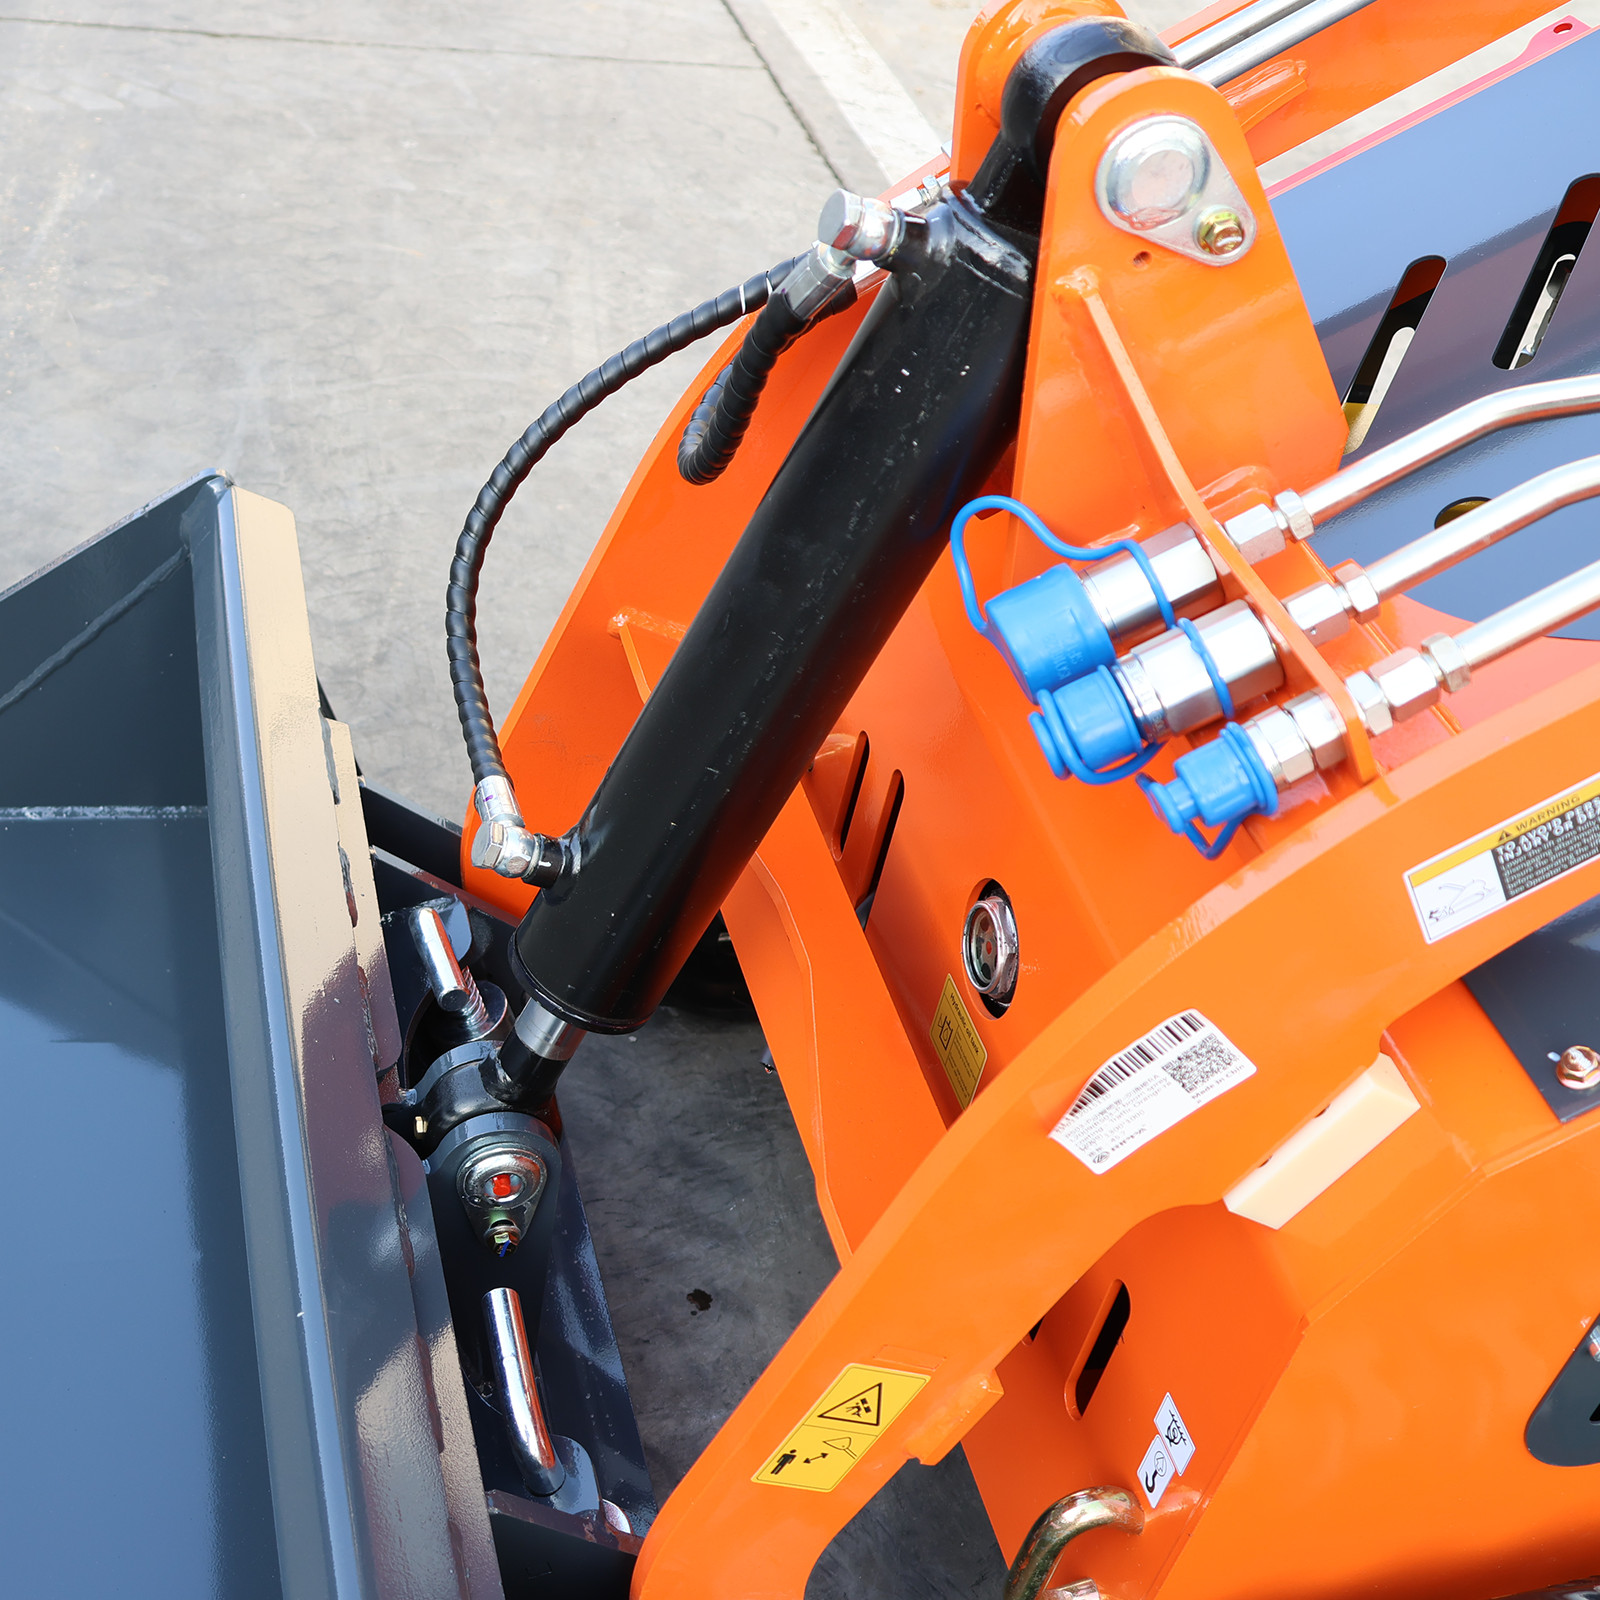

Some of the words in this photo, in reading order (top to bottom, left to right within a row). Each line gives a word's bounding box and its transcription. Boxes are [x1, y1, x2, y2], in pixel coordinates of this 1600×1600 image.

[1516, 796, 1580, 831] WARNING
[1496, 839, 1516, 855] TO
[1518, 816, 1562, 844] AVOID
[1498, 831, 1551, 863] INJURY
[1553, 819, 1574, 836] OR
[1528, 845, 1543, 857] the
